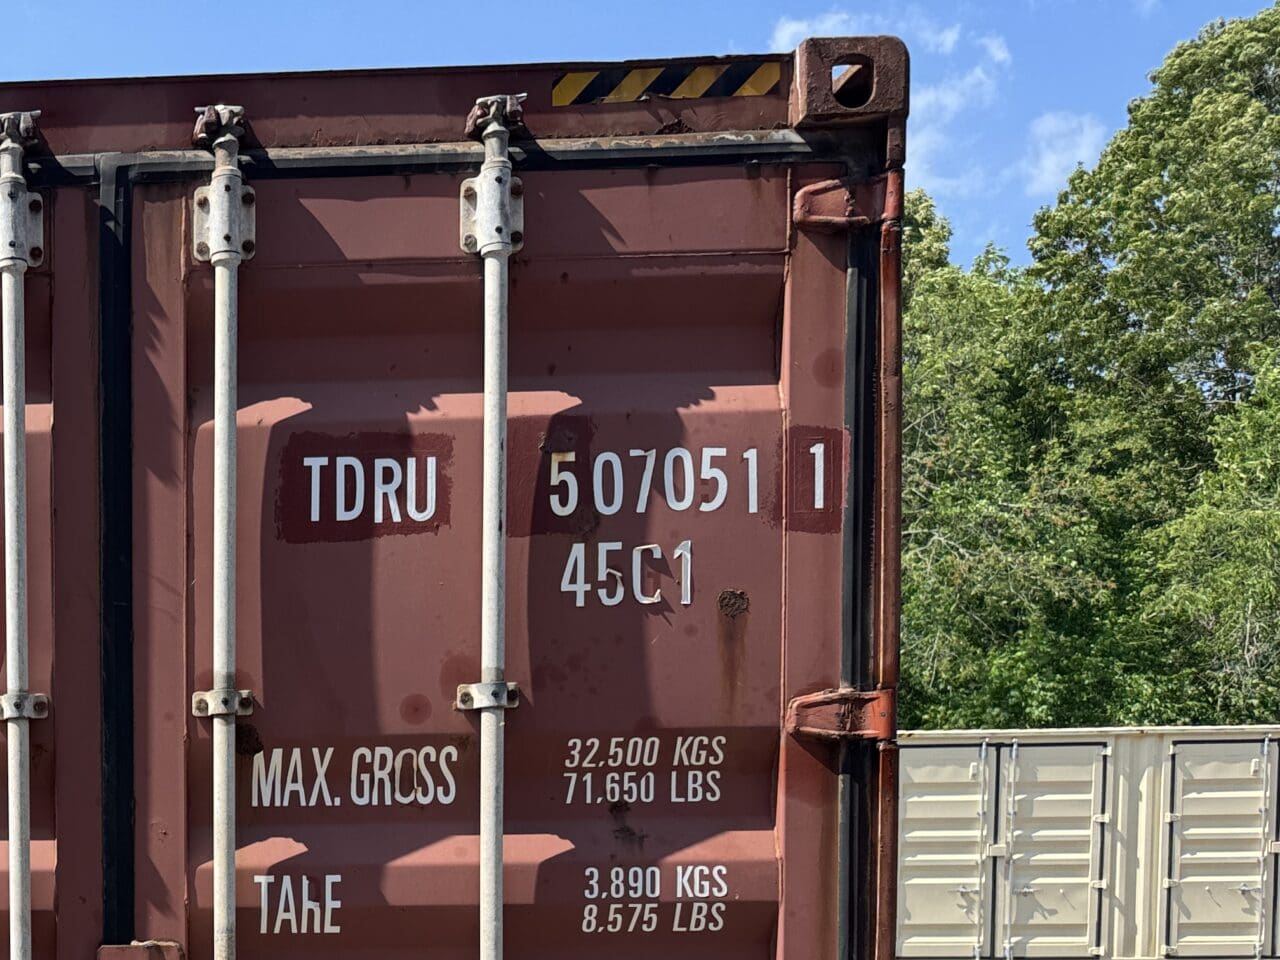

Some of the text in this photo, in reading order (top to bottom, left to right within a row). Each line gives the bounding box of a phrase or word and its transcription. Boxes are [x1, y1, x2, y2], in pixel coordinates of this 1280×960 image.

[303, 456, 437, 523] TDRU
[549, 443, 825, 517] 507051 1
[673, 736, 727, 766] KGS
[251, 745, 458, 807] MAX. GROSS
[670, 770, 721, 803] LBS
[676, 865, 728, 898] KGS
[672, 902, 726, 932] LBS
